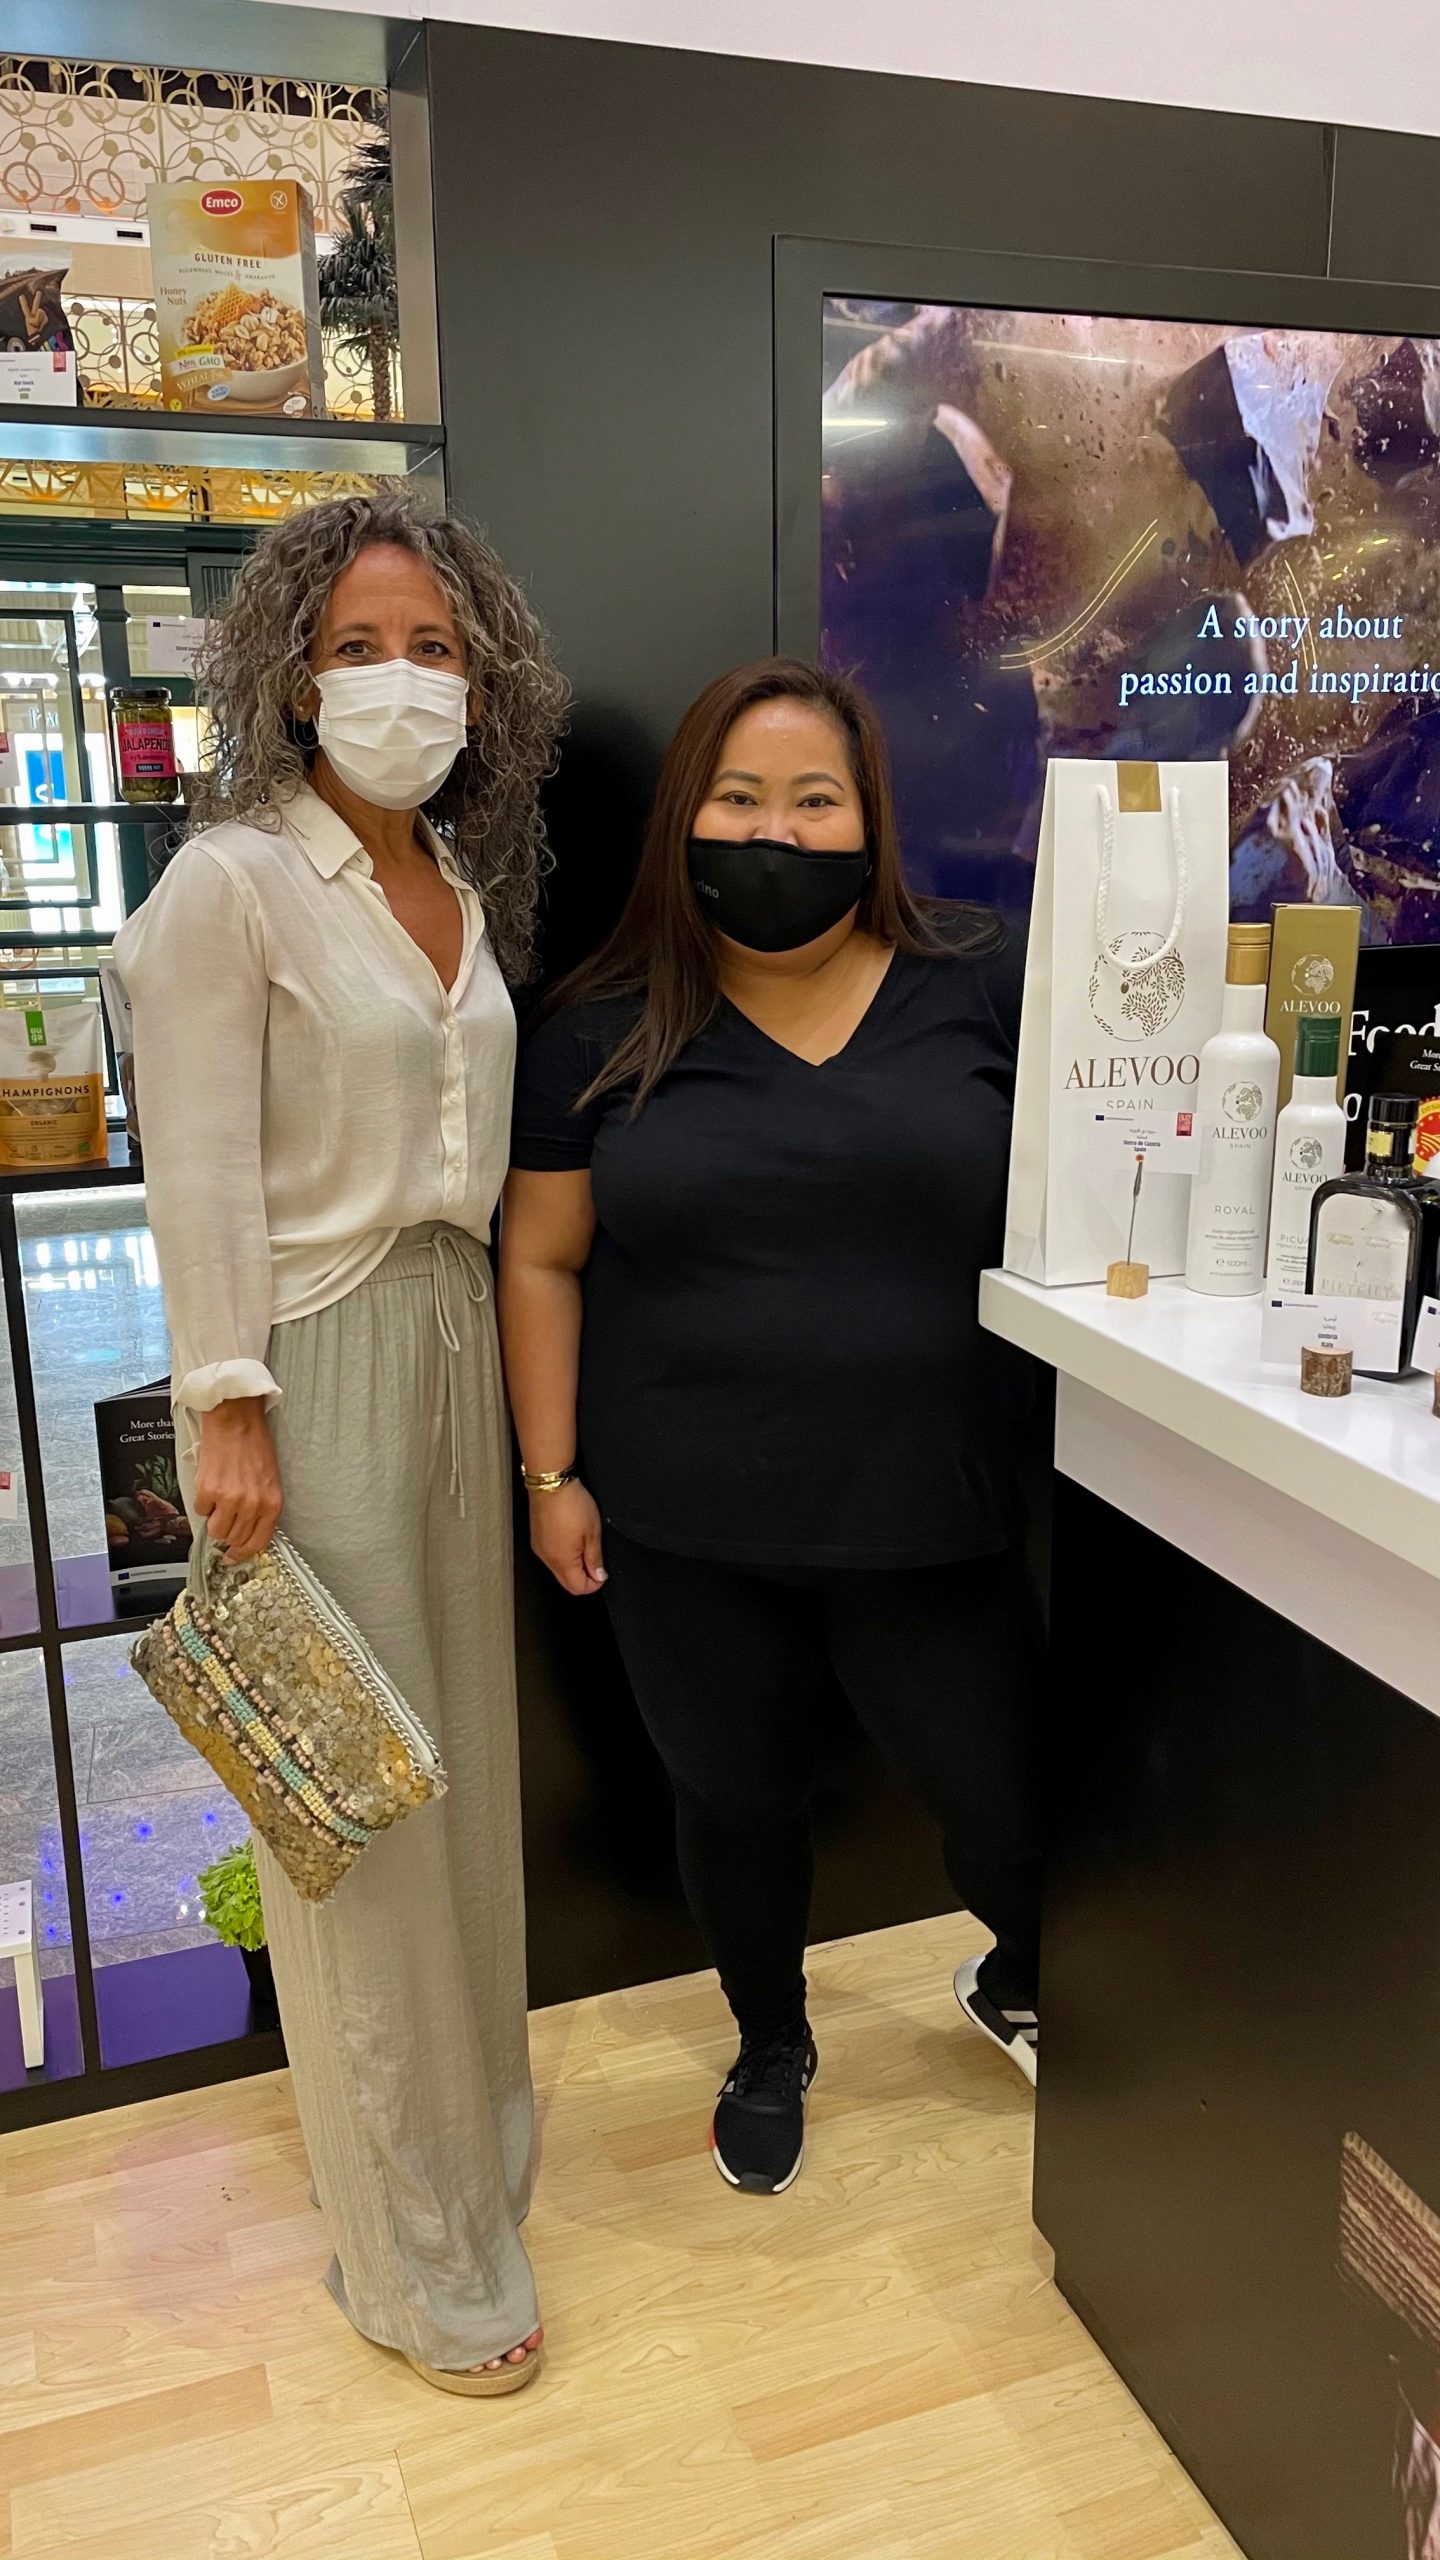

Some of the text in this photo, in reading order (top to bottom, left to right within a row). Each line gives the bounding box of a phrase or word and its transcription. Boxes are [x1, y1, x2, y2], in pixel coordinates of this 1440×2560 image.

[205, 196, 239, 208] Emco
[194, 252, 261, 269] GLUTEN FREE
[160, 286, 187, 297] Honey
[167, 297, 187, 305] Nuts
[200, 356, 221, 366] GMO
[1197, 604, 1403, 649] A story about
[1119, 663, 1232, 706] passion
[1243, 659, 1298, 694] and
[1279, 1000, 1341, 1014] ALEVOO
[1063, 1054, 1200, 1090] ALEVOO
[0, 1085, 90, 1098] HAMPIGNONS
[1106, 1098, 1153, 1110] SPAIN
[1211, 1126, 1268, 1140] ALEVOO
[1282, 1172, 1328, 1185] ALEVOO
[1214, 1205, 1255, 1215] ROYAL
[130, 1420, 155, 1429] More
[120, 1434, 145, 1443] Great
